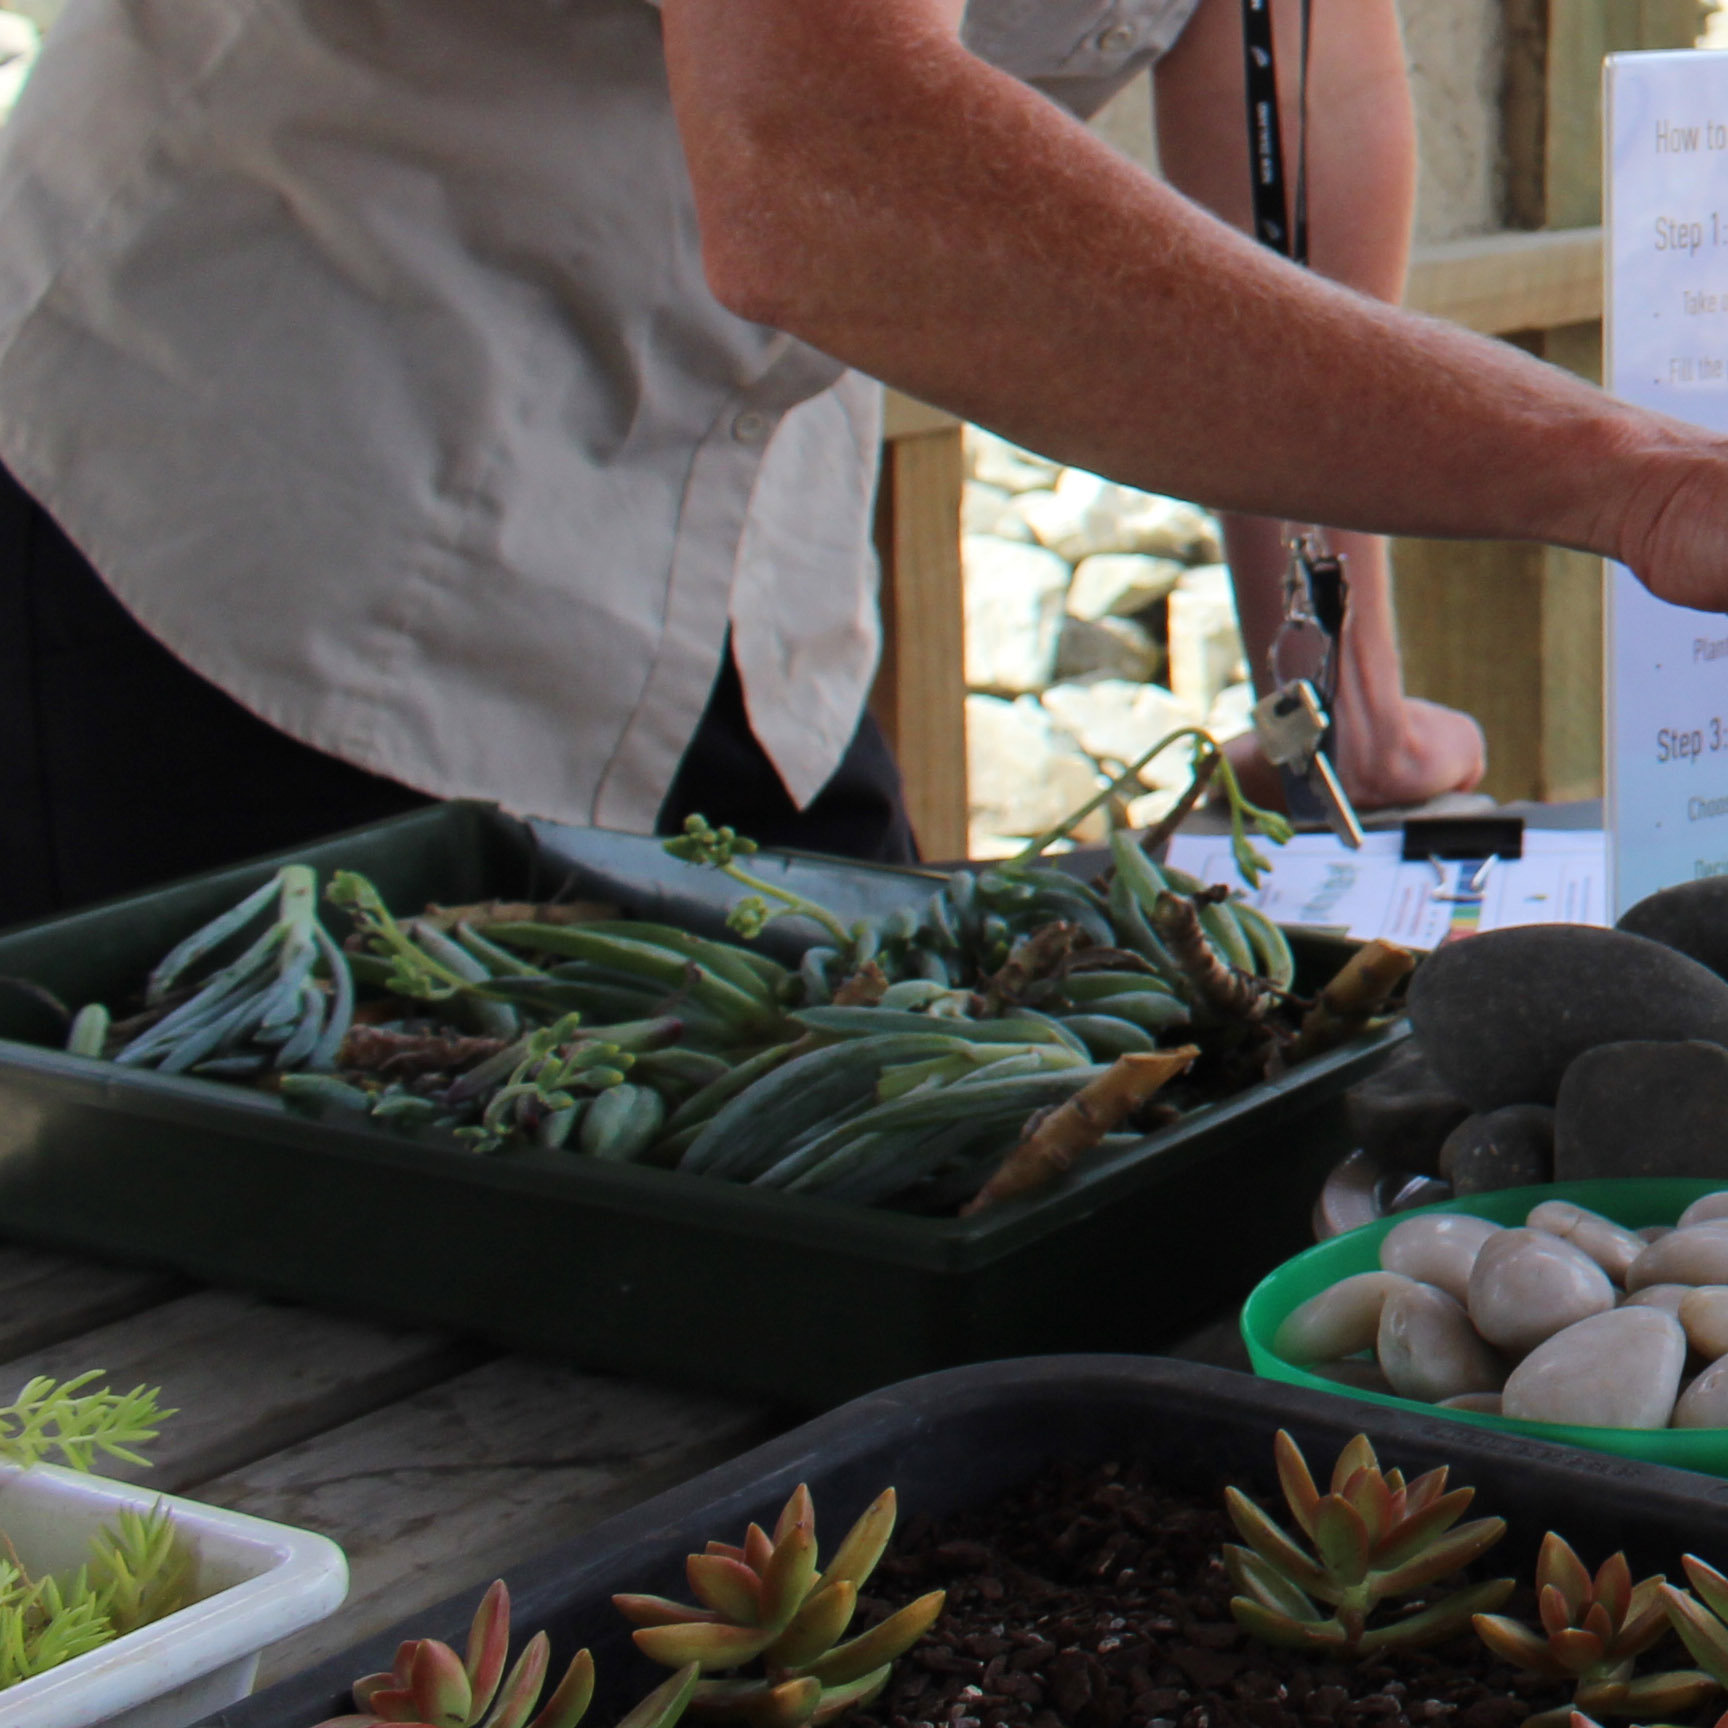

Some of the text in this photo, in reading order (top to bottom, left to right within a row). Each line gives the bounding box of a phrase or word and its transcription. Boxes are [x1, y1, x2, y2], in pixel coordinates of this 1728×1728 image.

[1655, 119, 1699, 153] How
[1707, 121, 1727, 150] to
[1654, 216, 1702, 256] Step
[1711, 211, 1728, 246] 1:
[1683, 288, 1717, 315] Take
[1669, 356, 1694, 383] Fill
[1698, 354, 1722, 379] the
[1656, 727, 1704, 765] Step
